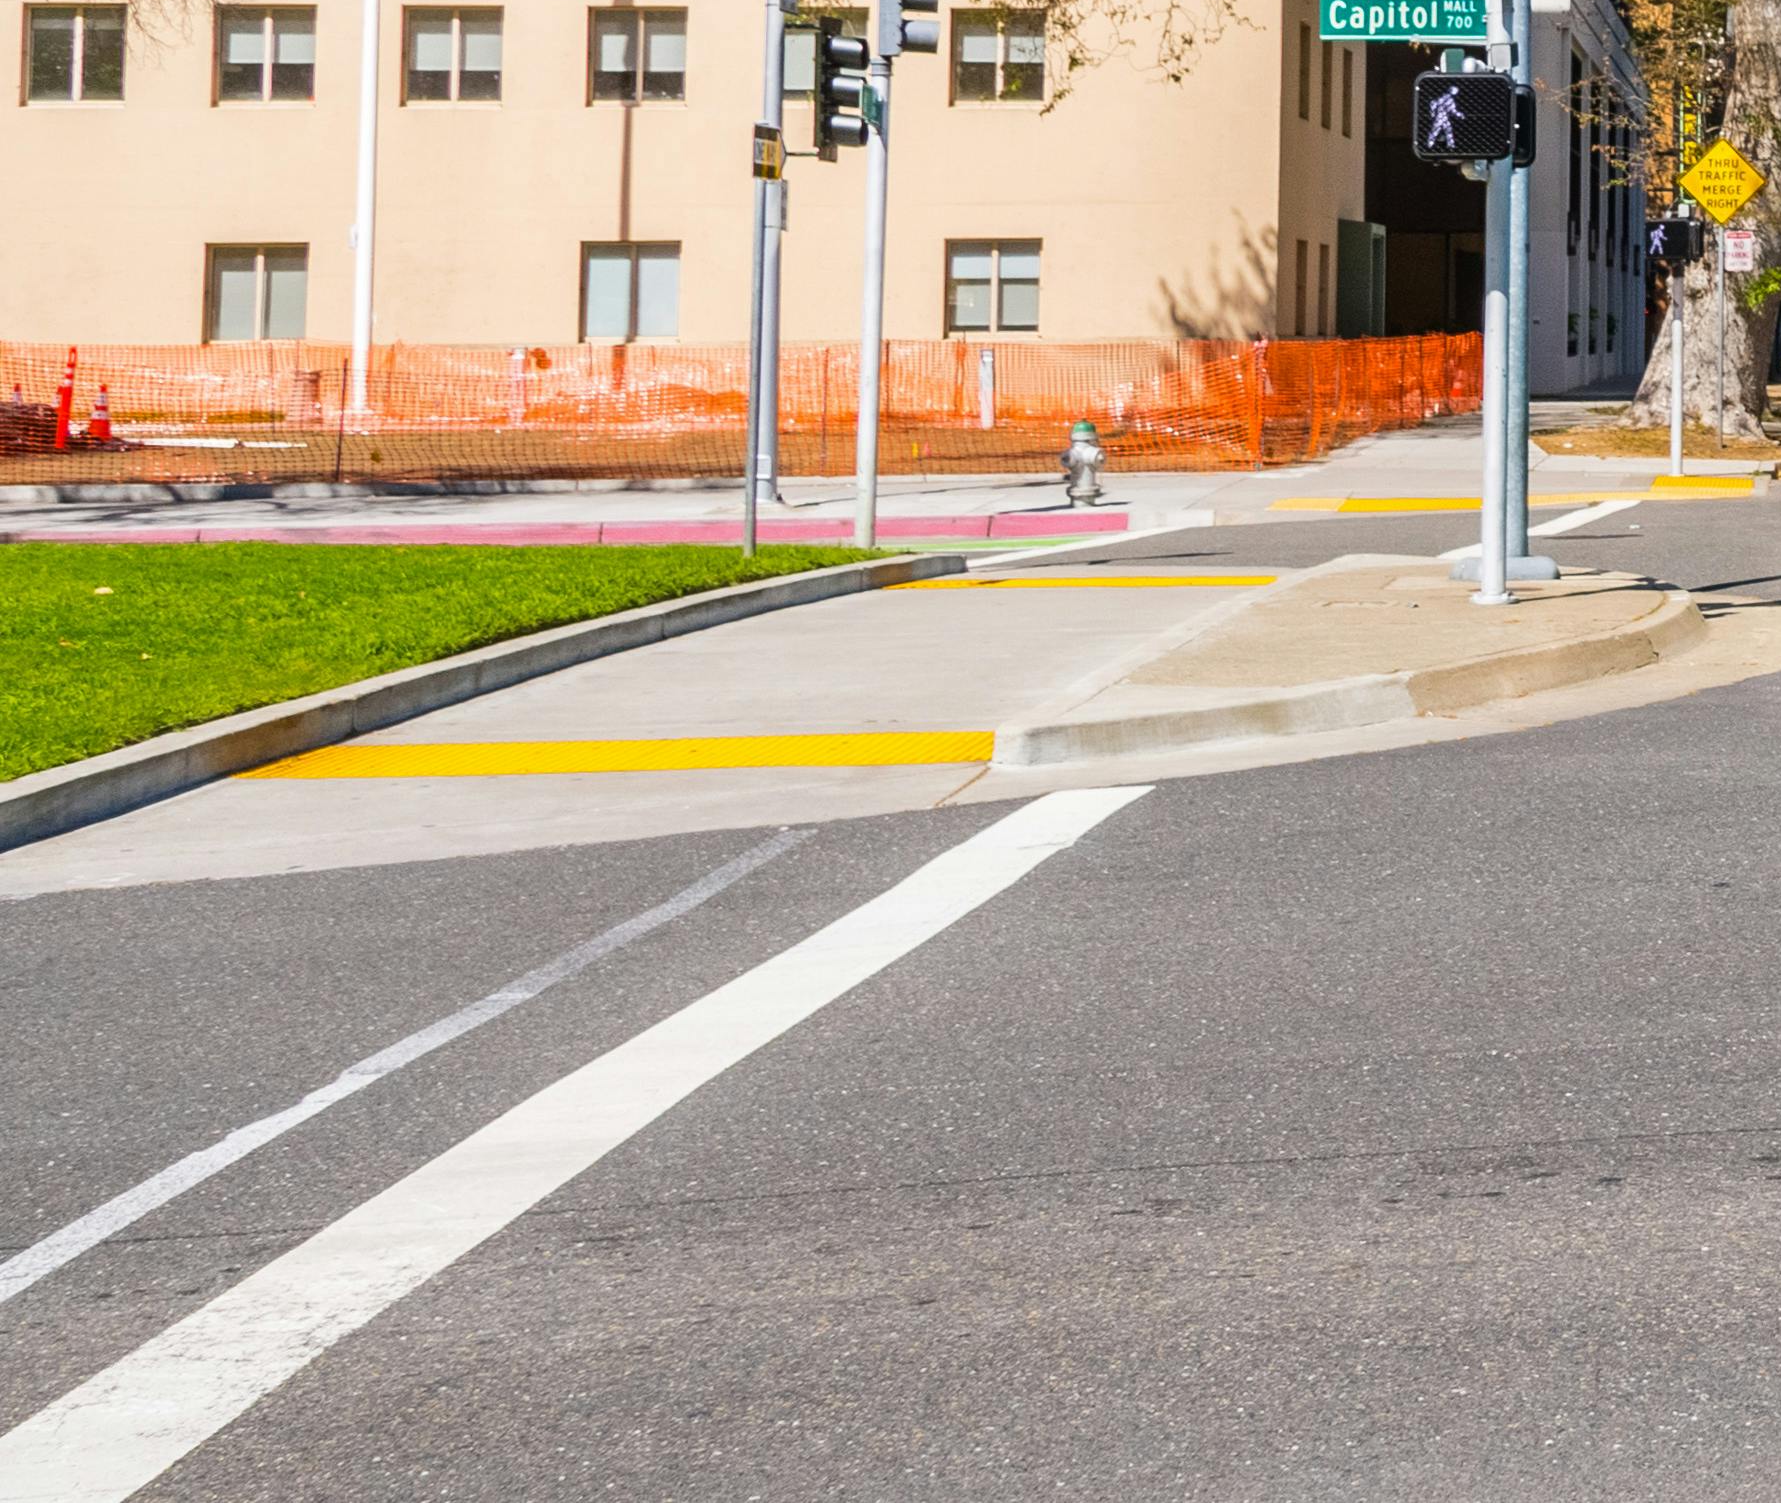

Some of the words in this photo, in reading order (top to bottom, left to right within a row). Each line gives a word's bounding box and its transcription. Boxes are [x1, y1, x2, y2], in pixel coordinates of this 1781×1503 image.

[1328, 0, 1437, 35] Capitol
[1443, 0, 1477, 12] MALL
[1446, 15, 1473, 29] 700
[1708, 158, 1740, 169] THRU
[1698, 170, 1747, 181] TRAFFIC
[1702, 184, 1742, 195] MERGE
[1706, 198, 1739, 208] RIGHT
